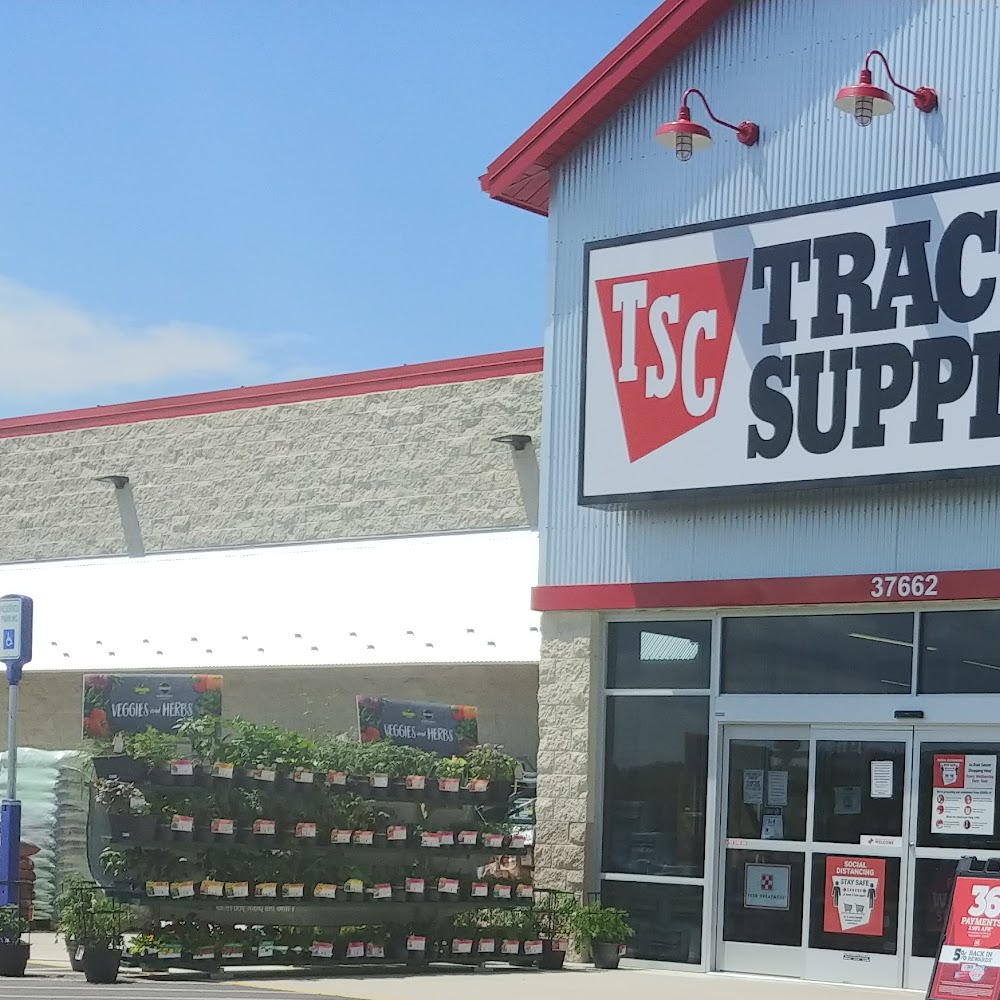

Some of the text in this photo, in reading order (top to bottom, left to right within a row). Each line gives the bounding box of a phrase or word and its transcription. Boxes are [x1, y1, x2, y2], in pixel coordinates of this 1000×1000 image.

[612, 279, 717, 418] TSC
[870, 575, 938, 598] 37662
[111, 702, 149, 718] VEGGIES
[162, 702, 193, 717] HERBS
[383, 724, 416, 739] VEGGIES
[427, 727, 454, 742] HERBS
[836, 867, 874, 876] DISTANCING
[844, 860, 867, 868] SOCIAL
[952, 948, 967, 961] 5%
